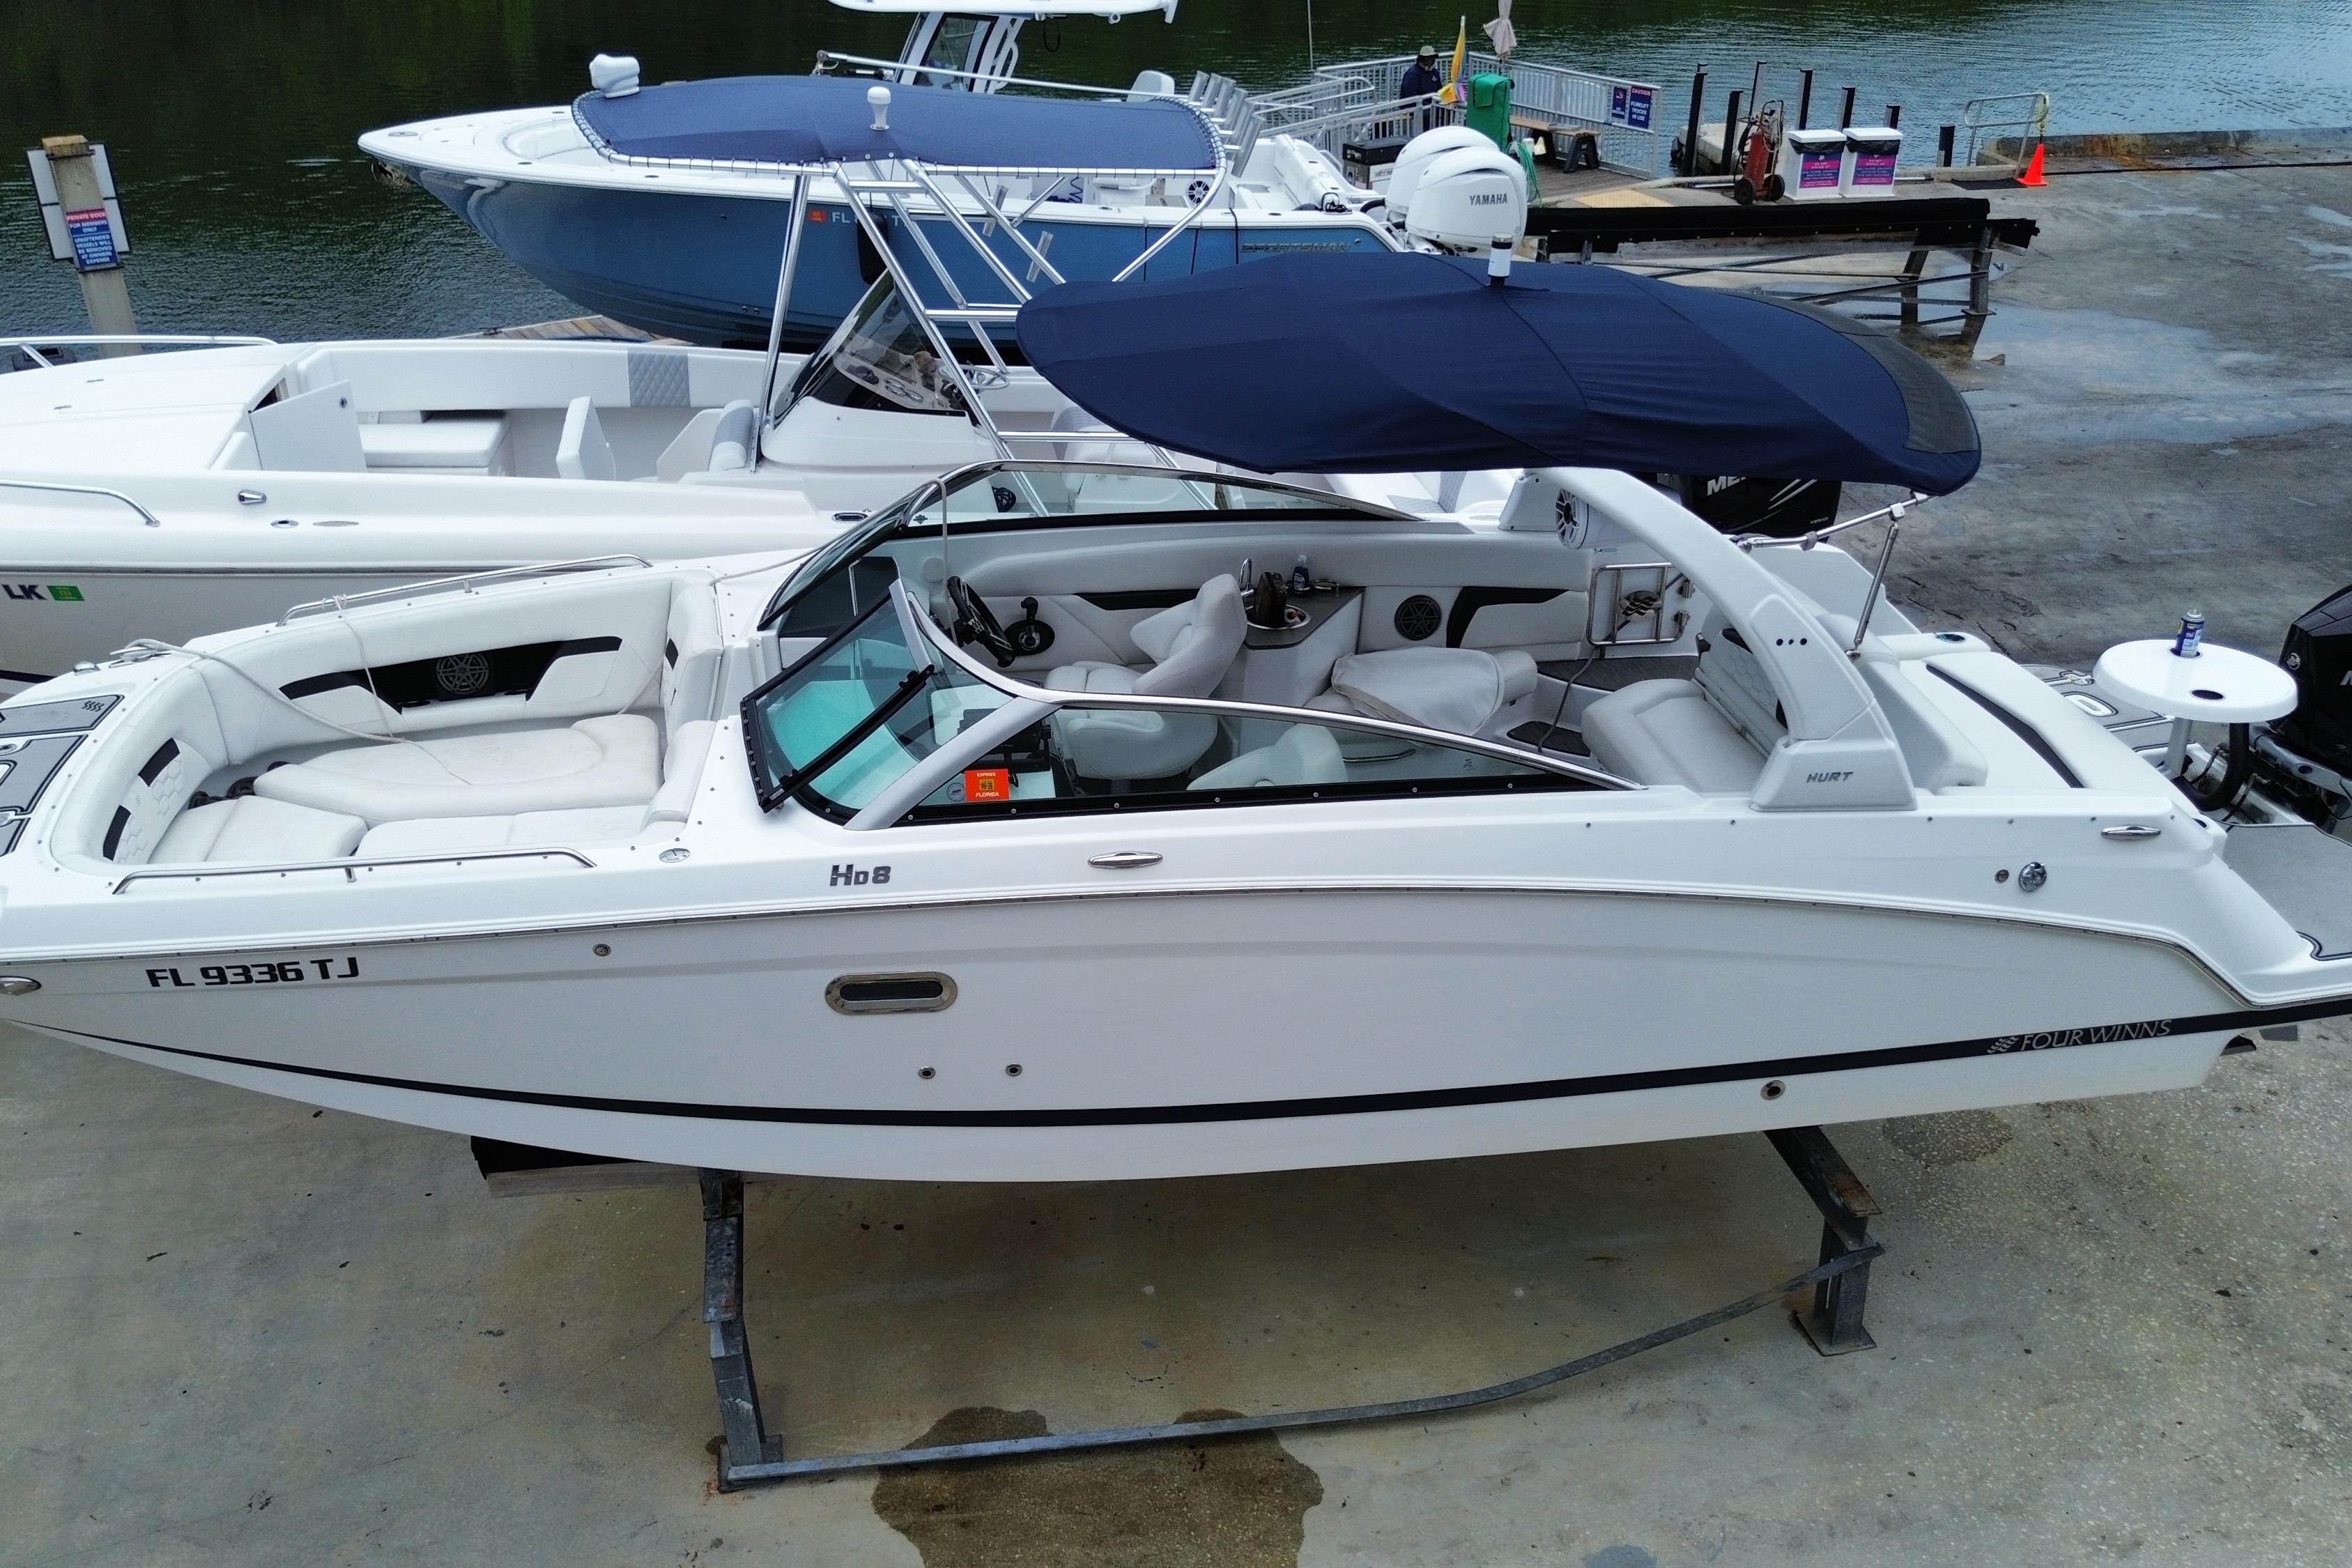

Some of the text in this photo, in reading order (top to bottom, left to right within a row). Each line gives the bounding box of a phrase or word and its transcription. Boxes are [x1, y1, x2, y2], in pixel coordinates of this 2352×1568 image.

[1631, 88, 1651, 96] CAUTION
[1469, 193, 1507, 206] YAMAHA
[831, 212, 850, 224] FL
[1, 584, 48, 601] LK
[146, 957, 360, 987] FL 9336 TJ
[2020, 1020, 2172, 1052] FOUR WINNS
